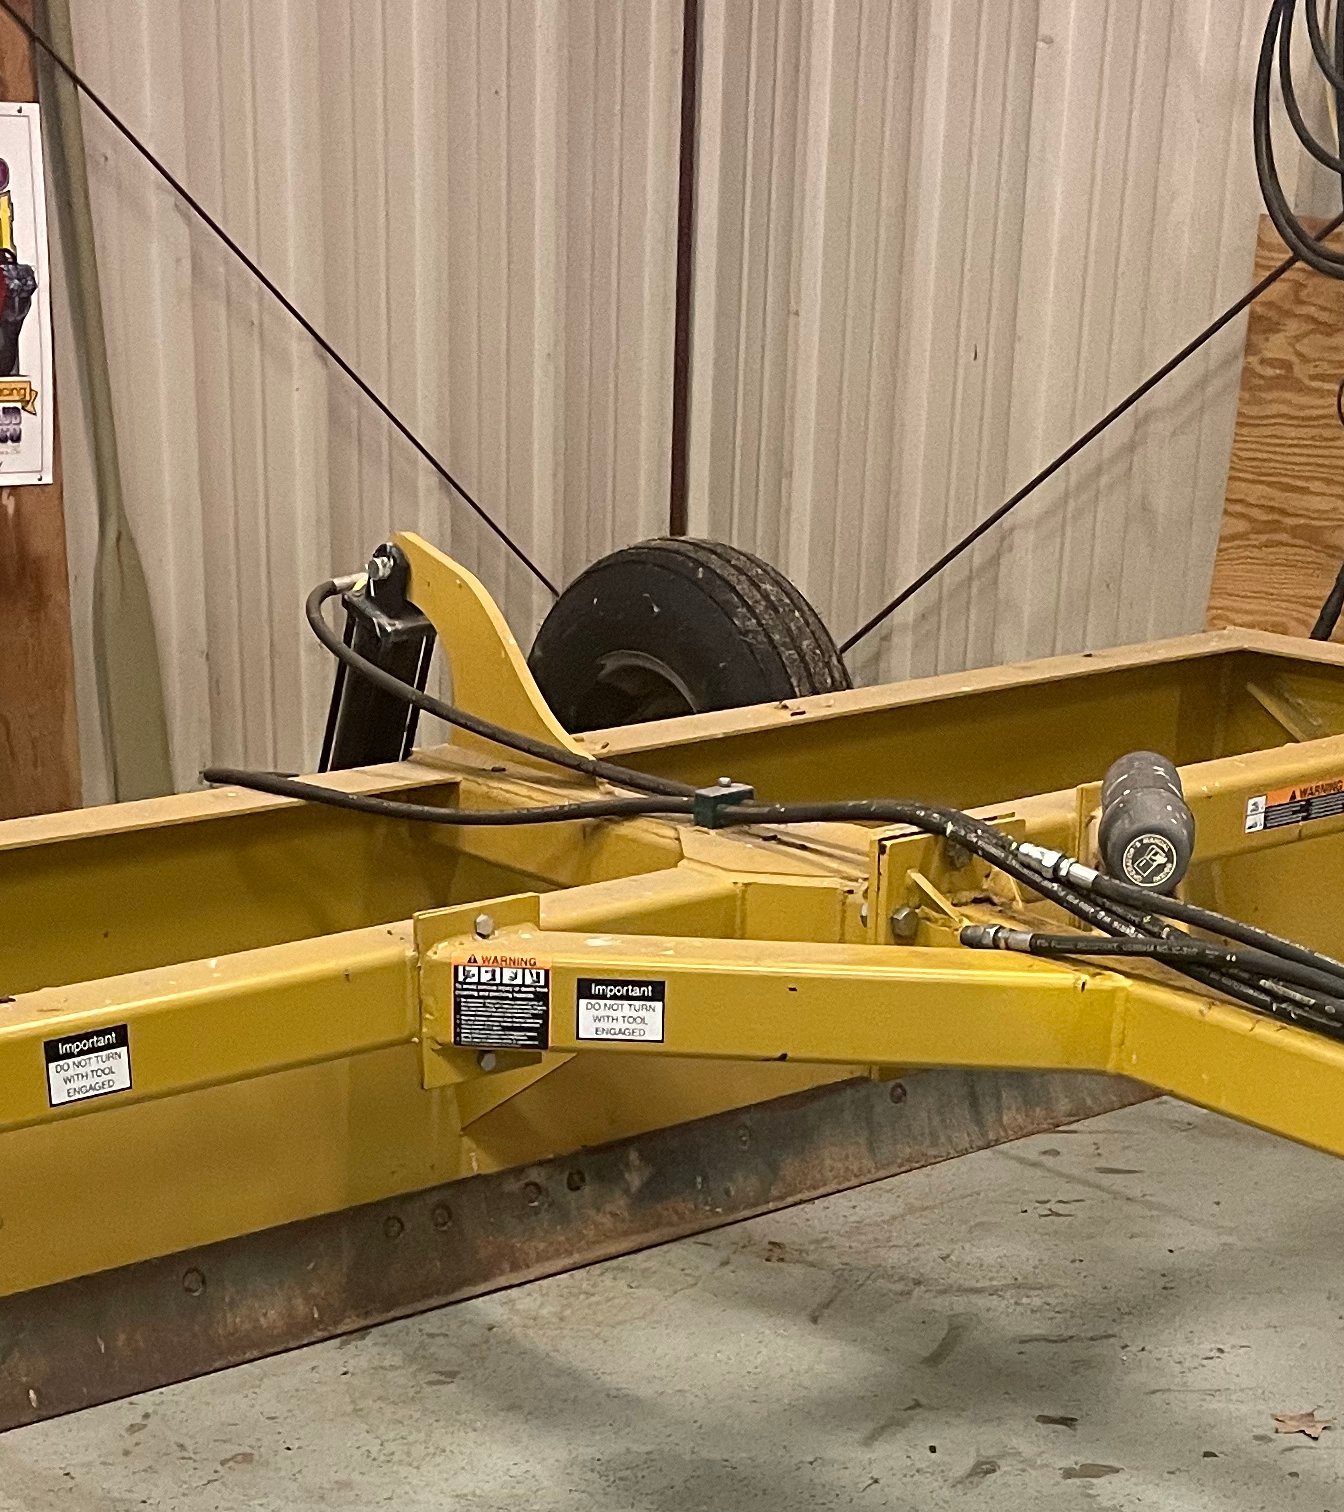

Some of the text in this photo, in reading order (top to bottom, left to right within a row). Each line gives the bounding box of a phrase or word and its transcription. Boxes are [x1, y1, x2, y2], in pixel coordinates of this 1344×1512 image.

[1299, 780, 1344, 798] WARNING
[481, 956, 536, 966] WARNING
[591, 983, 652, 998] Important
[586, 1002, 656, 1012] DO NOT TURN
[592, 1014, 648, 1025] WITH TOOL
[595, 1027, 645, 1036] ENGAGED
[58, 1032, 116, 1055] Important
[55, 1051, 122, 1073] DO NOT TURN
[63, 1066, 115, 1085] WITH TOOL
[66, 1079, 115, 1097] ENGAGED
